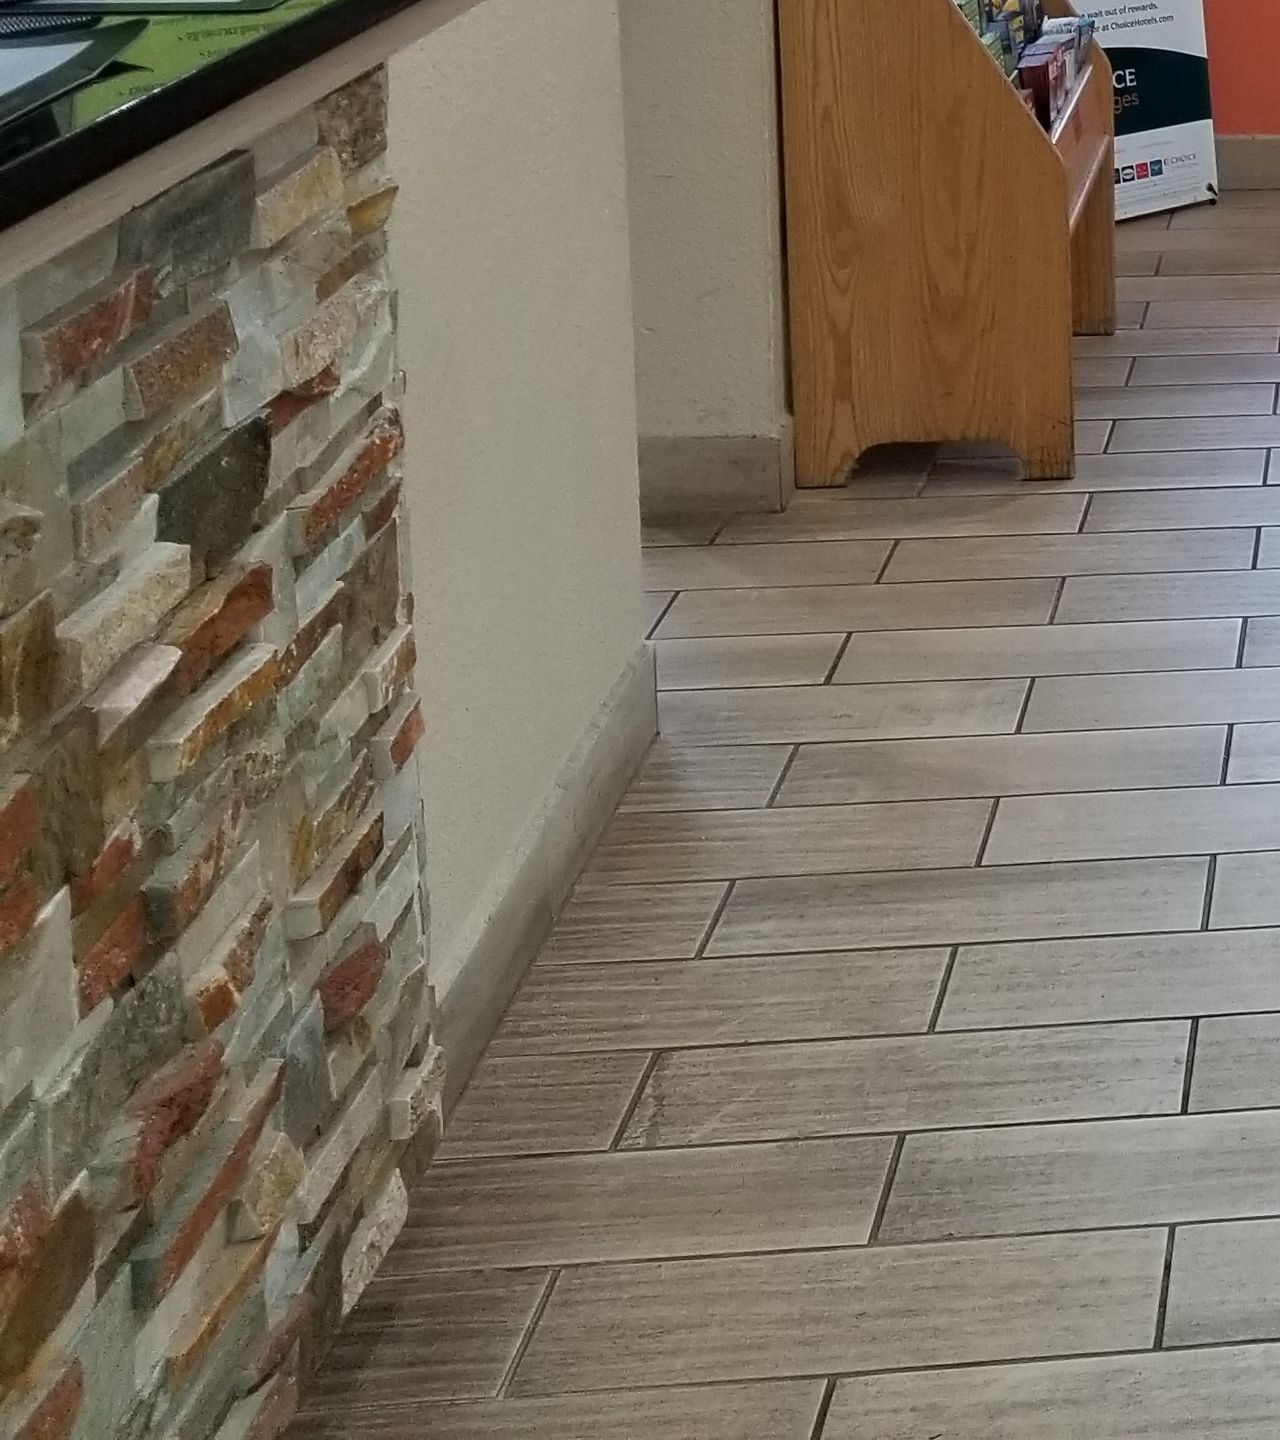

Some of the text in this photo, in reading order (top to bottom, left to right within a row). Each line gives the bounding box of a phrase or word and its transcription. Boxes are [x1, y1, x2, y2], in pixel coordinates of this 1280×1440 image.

[1087, 9, 1104, 19] wait
[1105, 8, 1118, 17] out
[1118, 5, 1127, 15] of
[1101, 23, 1110, 31] at
[1110, 14, 1174, 30] ChoiceHotels.com
[1112, 68, 1137, 88] CE
[1113, 92, 1140, 114] ges
